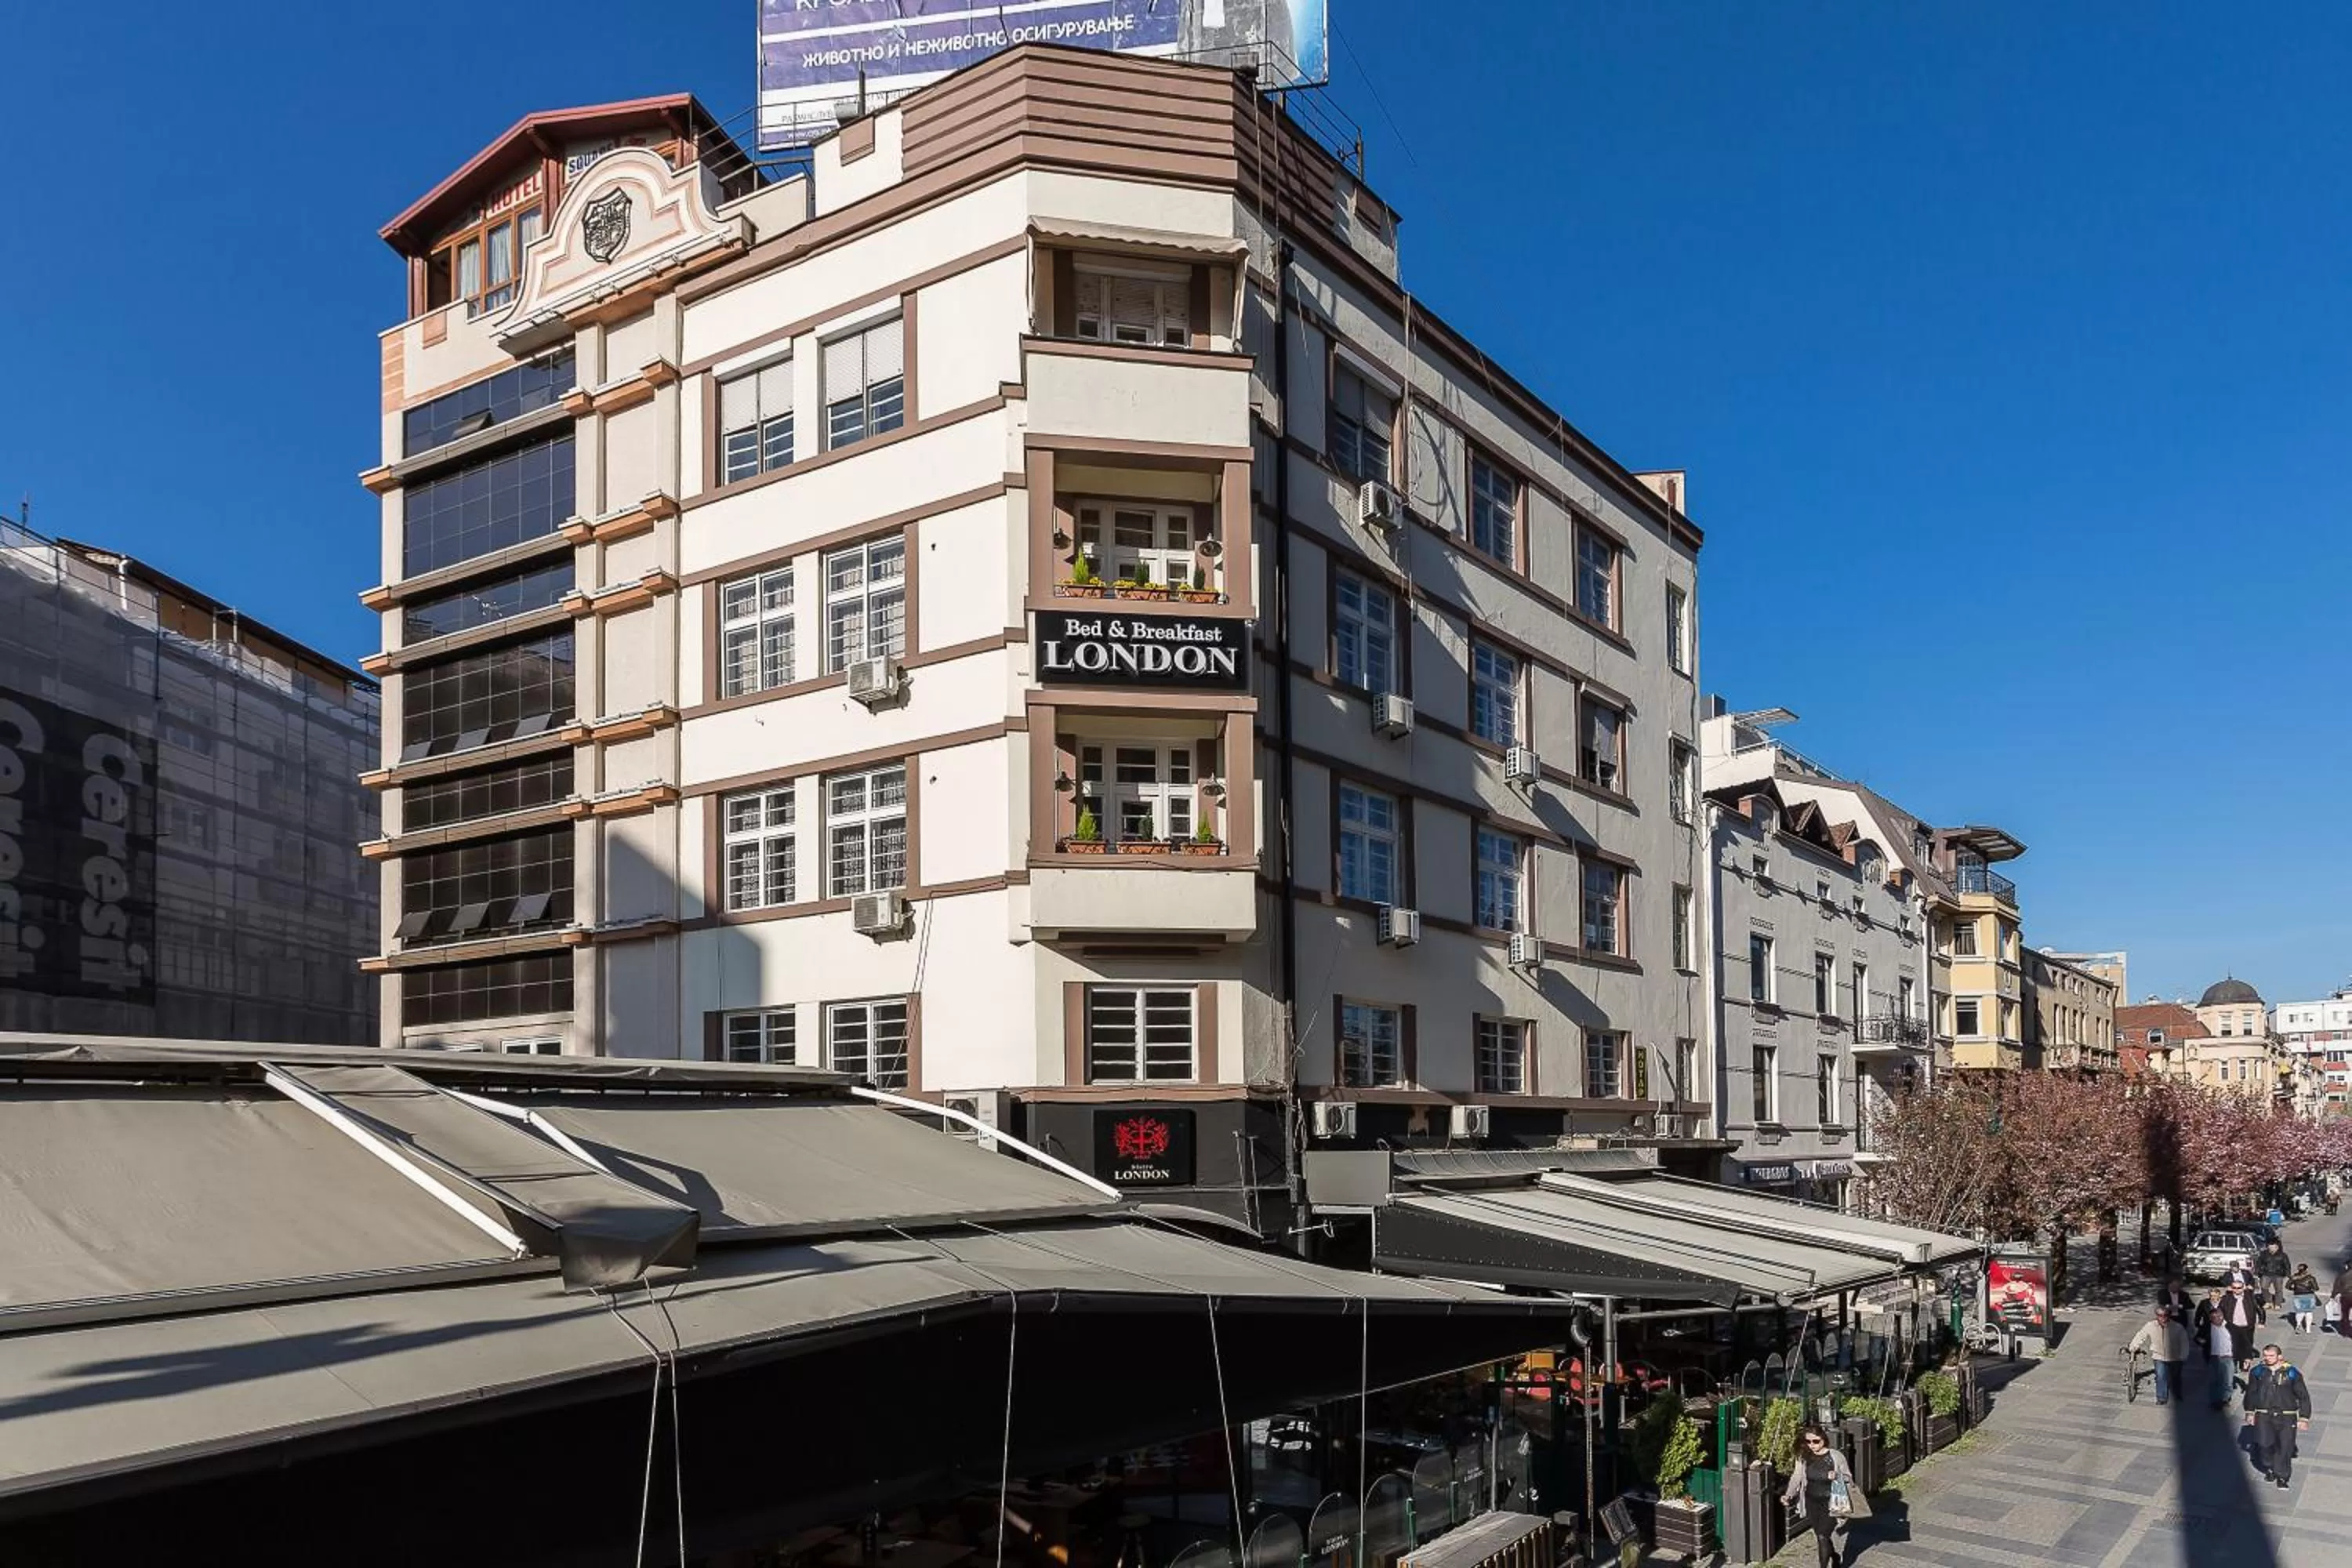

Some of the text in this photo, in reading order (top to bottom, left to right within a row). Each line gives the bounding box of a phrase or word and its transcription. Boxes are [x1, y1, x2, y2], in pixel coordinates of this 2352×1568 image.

[803, 14, 1134, 68] ЖИВОТНО И НЕЖИВОТНО ОСИГУРУВАЊЕ
[492, 175, 540, 213] HOTEL
[1065, 619, 1223, 642] Bed & Breakfast
[1042, 641, 1239, 675] LONDON
[80, 732, 149, 991] Ceresit
[1114, 1169, 1171, 1181] LONDON
